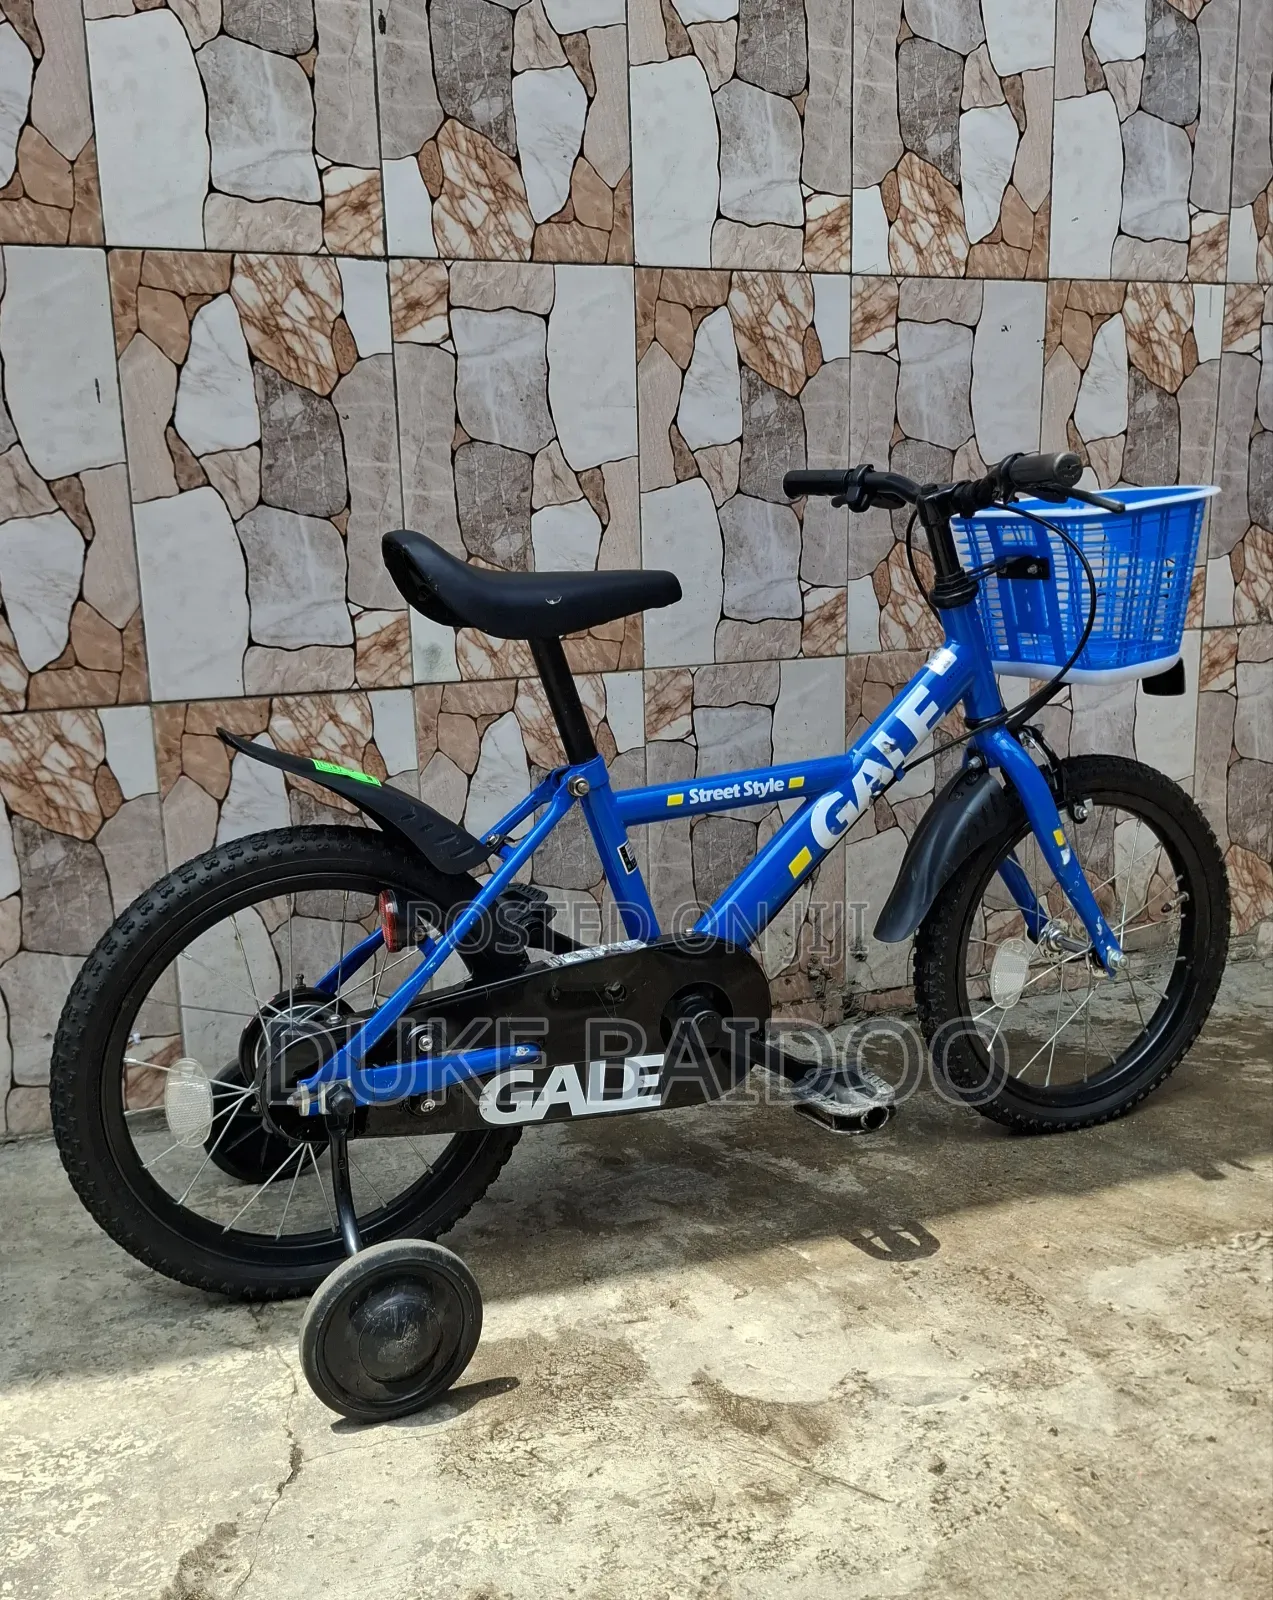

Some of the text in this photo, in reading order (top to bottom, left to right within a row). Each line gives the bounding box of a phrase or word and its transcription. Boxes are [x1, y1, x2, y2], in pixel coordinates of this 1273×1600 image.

[689, 777, 785, 805] Street Style
[478, 1053, 665, 1125] GALE
